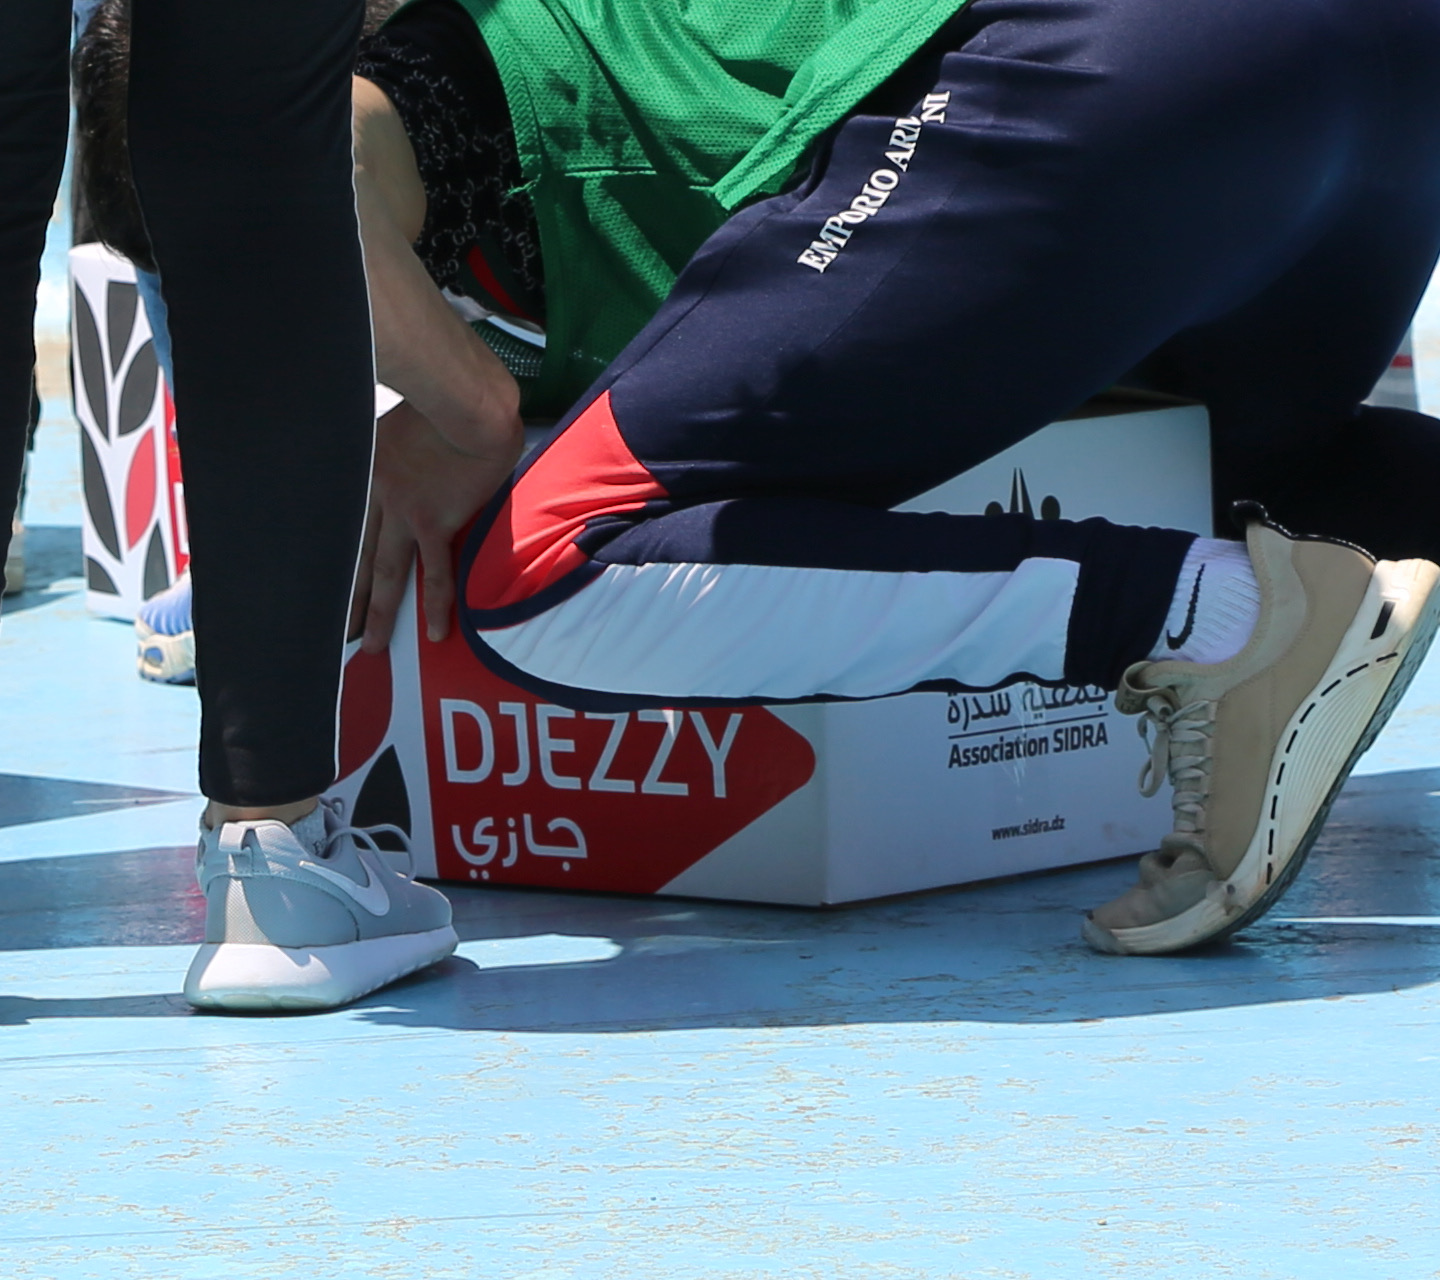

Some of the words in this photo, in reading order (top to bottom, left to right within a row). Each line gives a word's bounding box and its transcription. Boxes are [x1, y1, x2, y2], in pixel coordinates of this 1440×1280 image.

[796, 168, 900, 274] EMPORIO
[884, 90, 952, 173] ARMNI
[439, 697, 744, 799] DJEZZY
[947, 734, 1049, 769] Association
[1052, 721, 1109, 753] SIDRA
[451, 813, 588, 880] جازي
[991, 814, 1066, 841] www.sidra.dz
